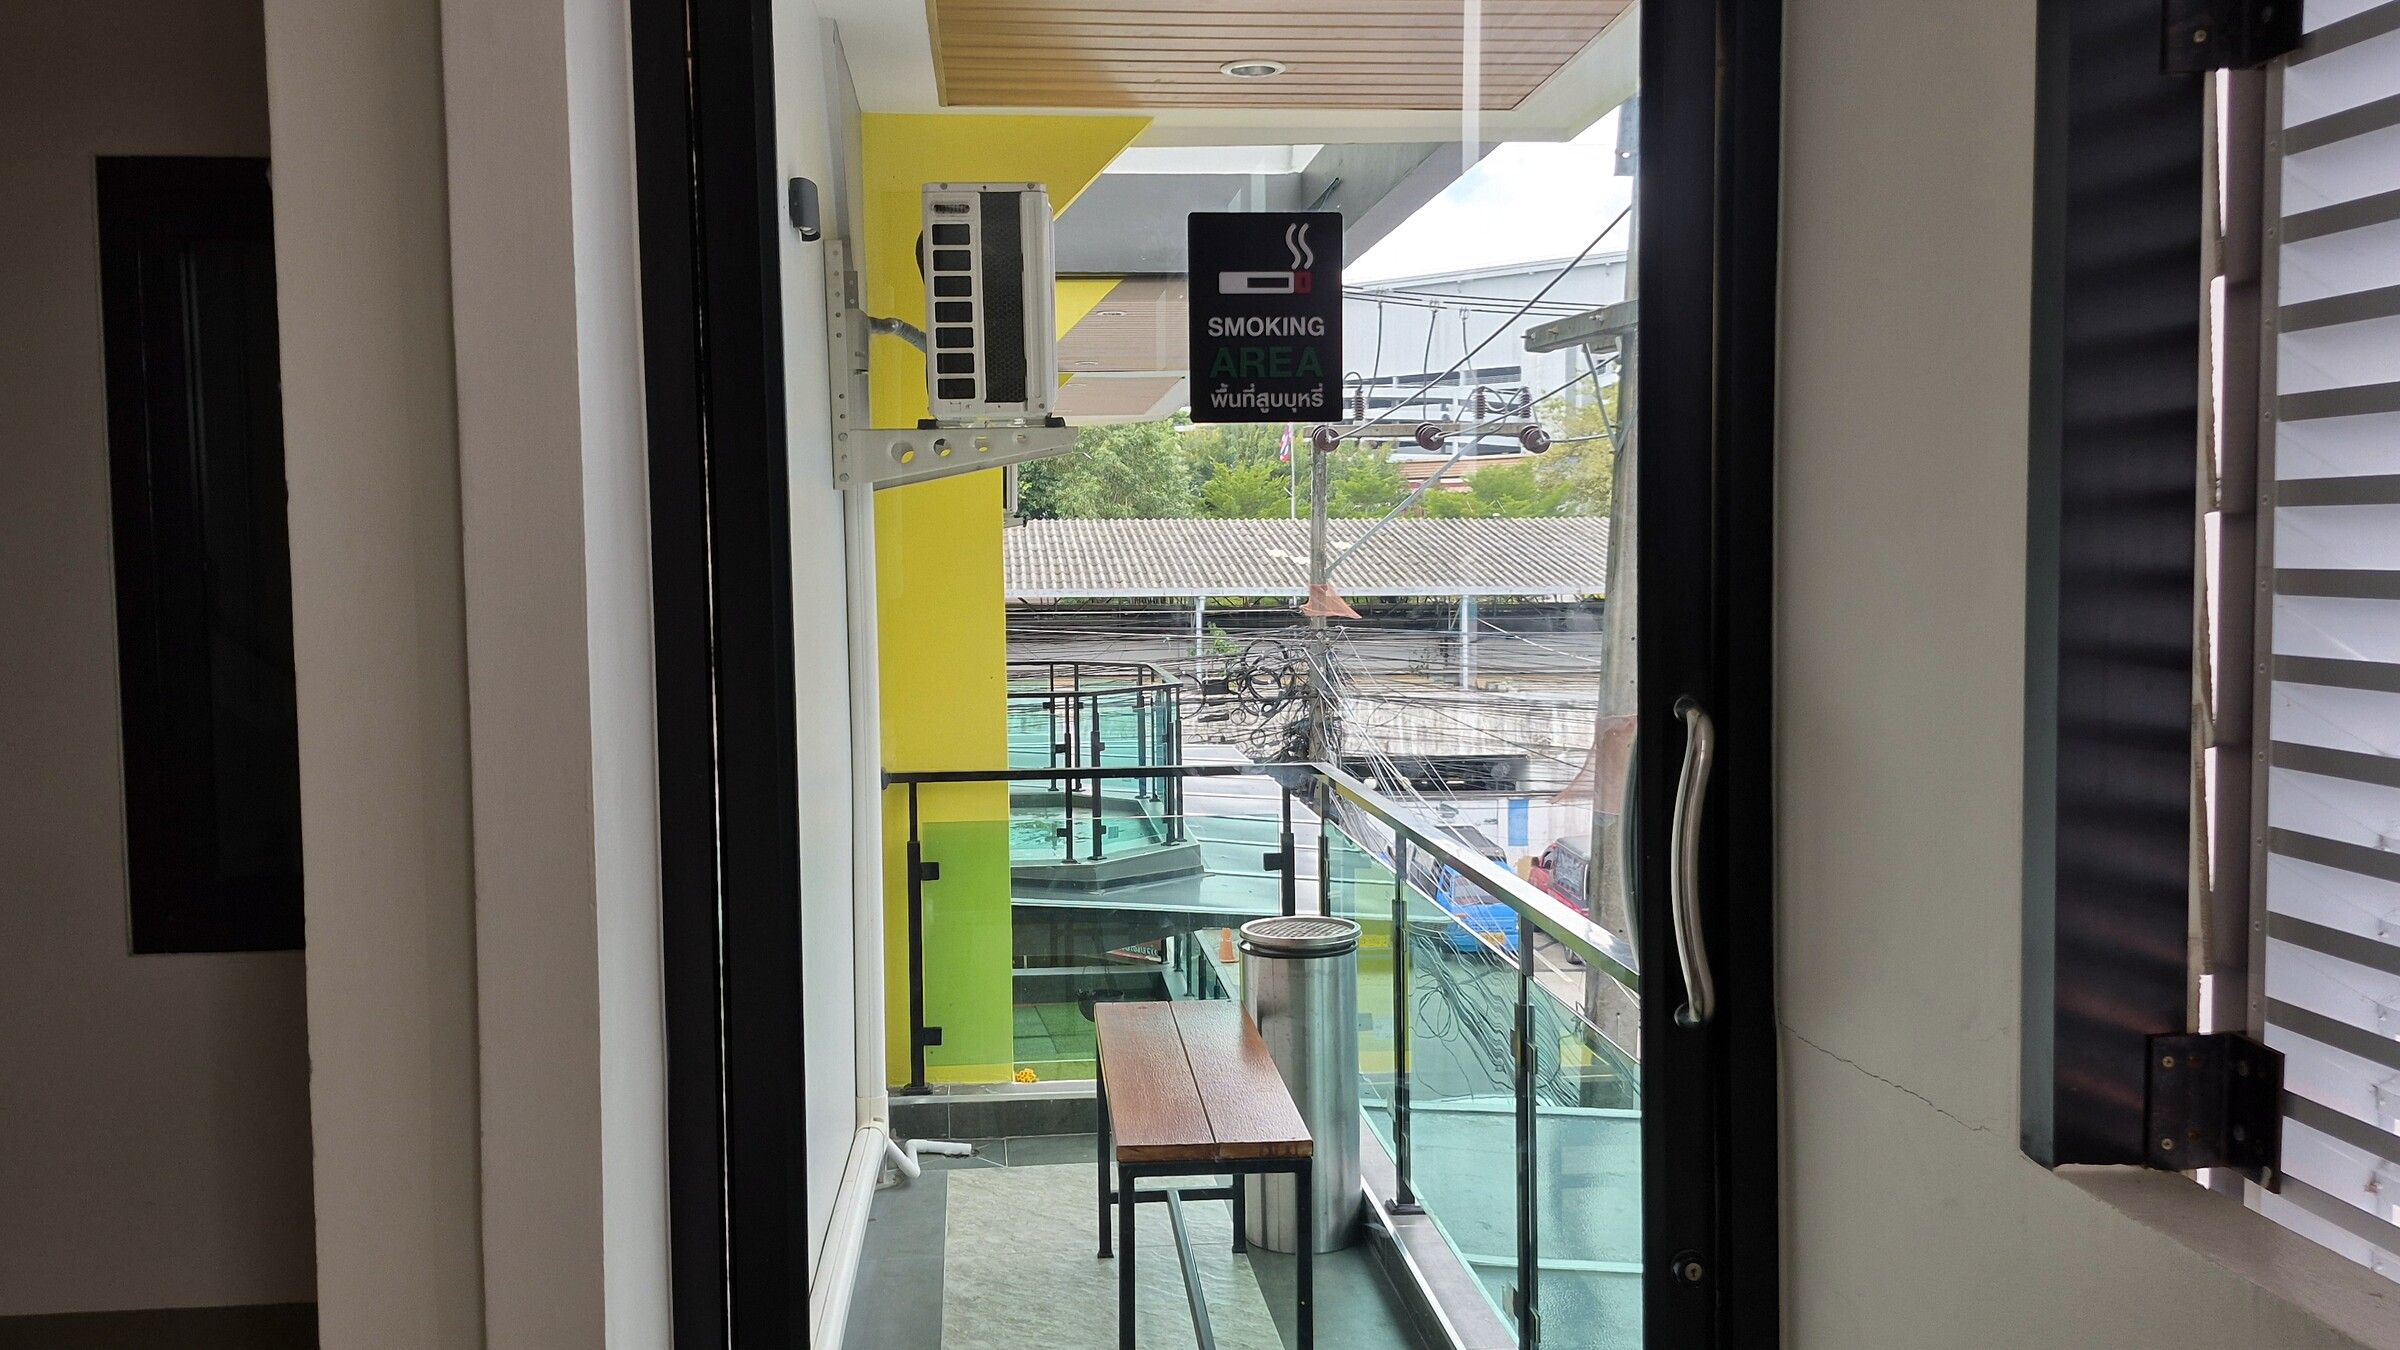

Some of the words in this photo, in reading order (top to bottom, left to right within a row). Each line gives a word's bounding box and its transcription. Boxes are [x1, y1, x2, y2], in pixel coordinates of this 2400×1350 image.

[1208, 316, 1325, 337] SMOKING
[1209, 346, 1324, 378] AREA
[1210, 382, 1324, 413] พื้นที่สูบบุหรี่
